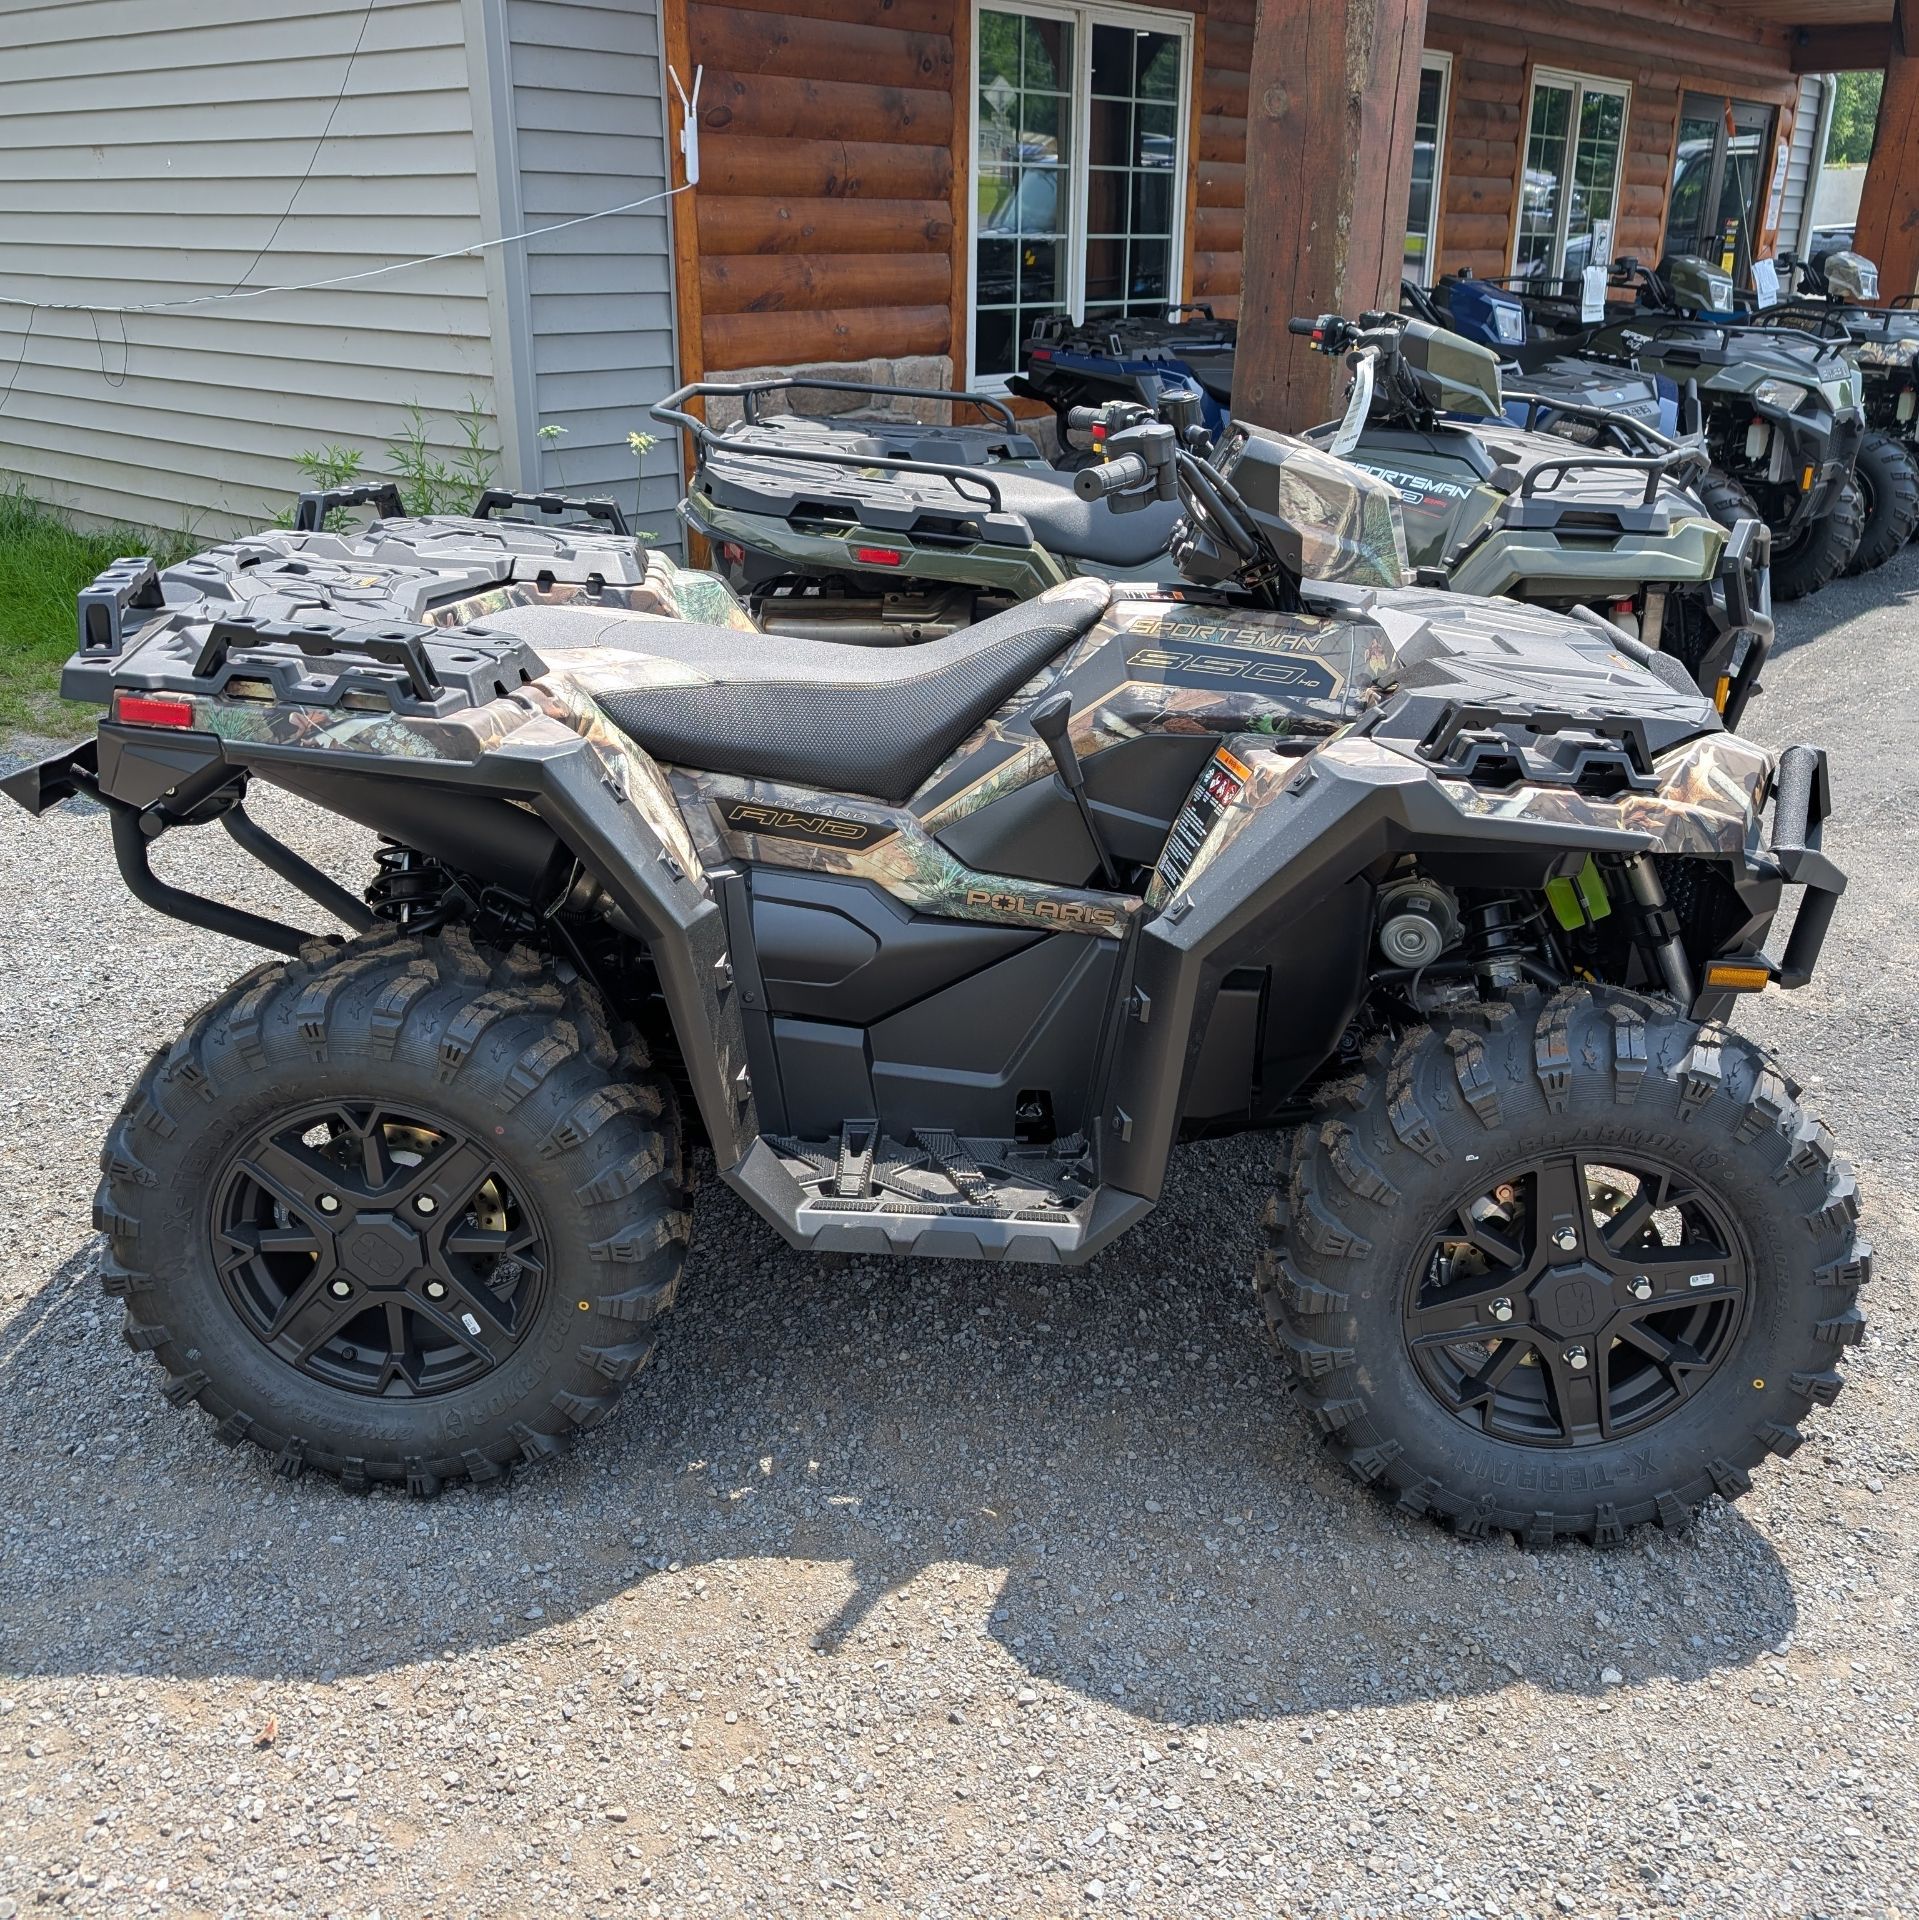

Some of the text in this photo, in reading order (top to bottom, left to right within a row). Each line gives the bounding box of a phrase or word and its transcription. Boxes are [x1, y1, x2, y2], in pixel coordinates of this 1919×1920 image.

[1128, 619, 1322, 652] SPORTSMAN
[1126, 649, 1308, 685] 850
[728, 805, 868, 840] AWD
[732, 792, 868, 820] ON DEMAND
[965, 888, 1117, 927] POLARIS
[1572, 1124, 1692, 1156] ARMOR
[1453, 1447, 1662, 1494] X-TERRAIN
